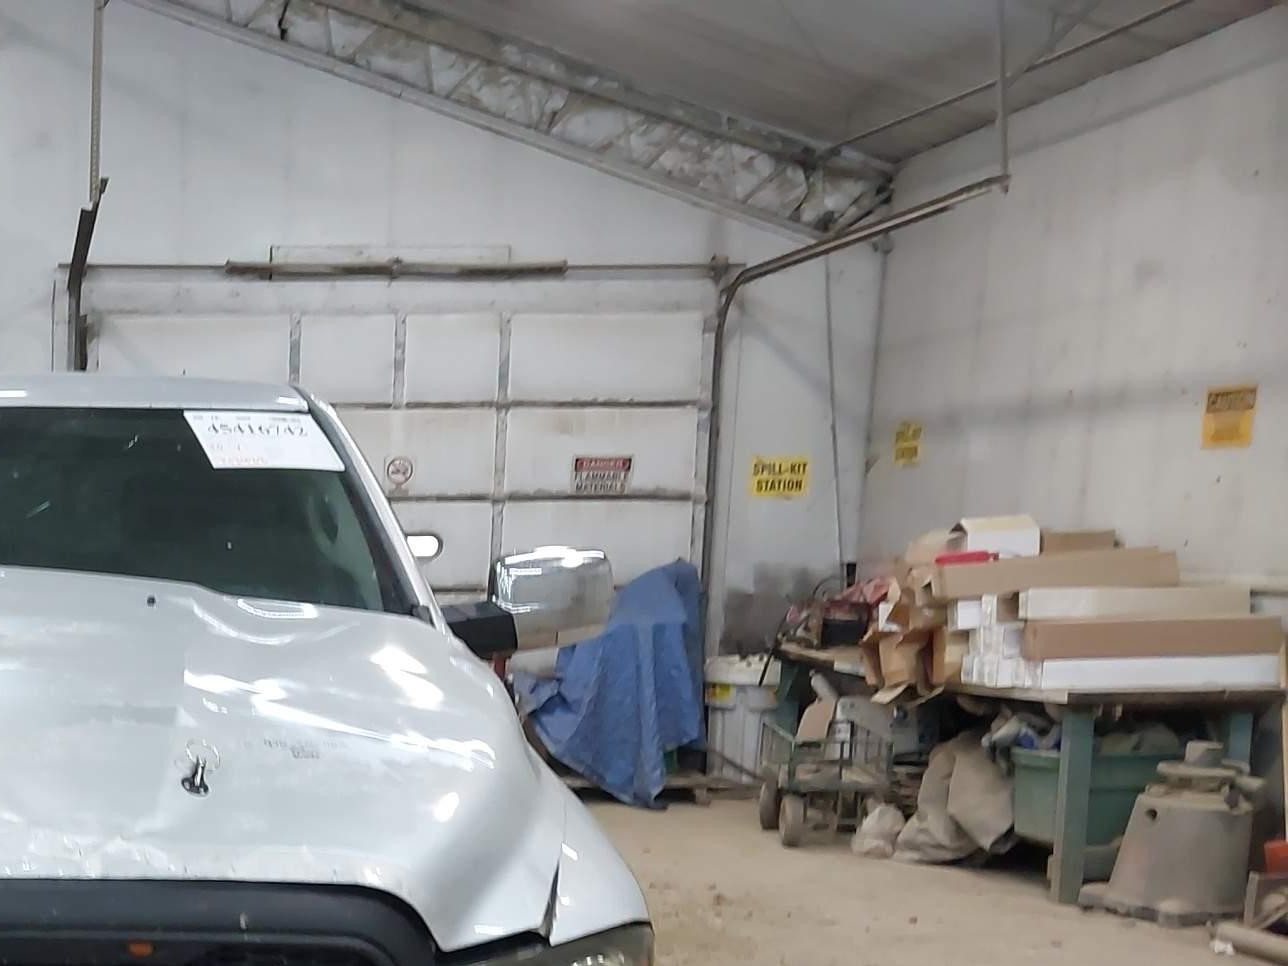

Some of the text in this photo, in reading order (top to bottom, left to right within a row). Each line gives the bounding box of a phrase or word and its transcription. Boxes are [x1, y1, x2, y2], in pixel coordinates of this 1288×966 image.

[207, 423, 309, 437] 45416742
[753, 462, 808, 476] SPILL-KIT
[574, 471, 627, 481] FLAMMABLE
[575, 481, 626, 492] MATERIALS
[756, 479, 803, 492] STATION
